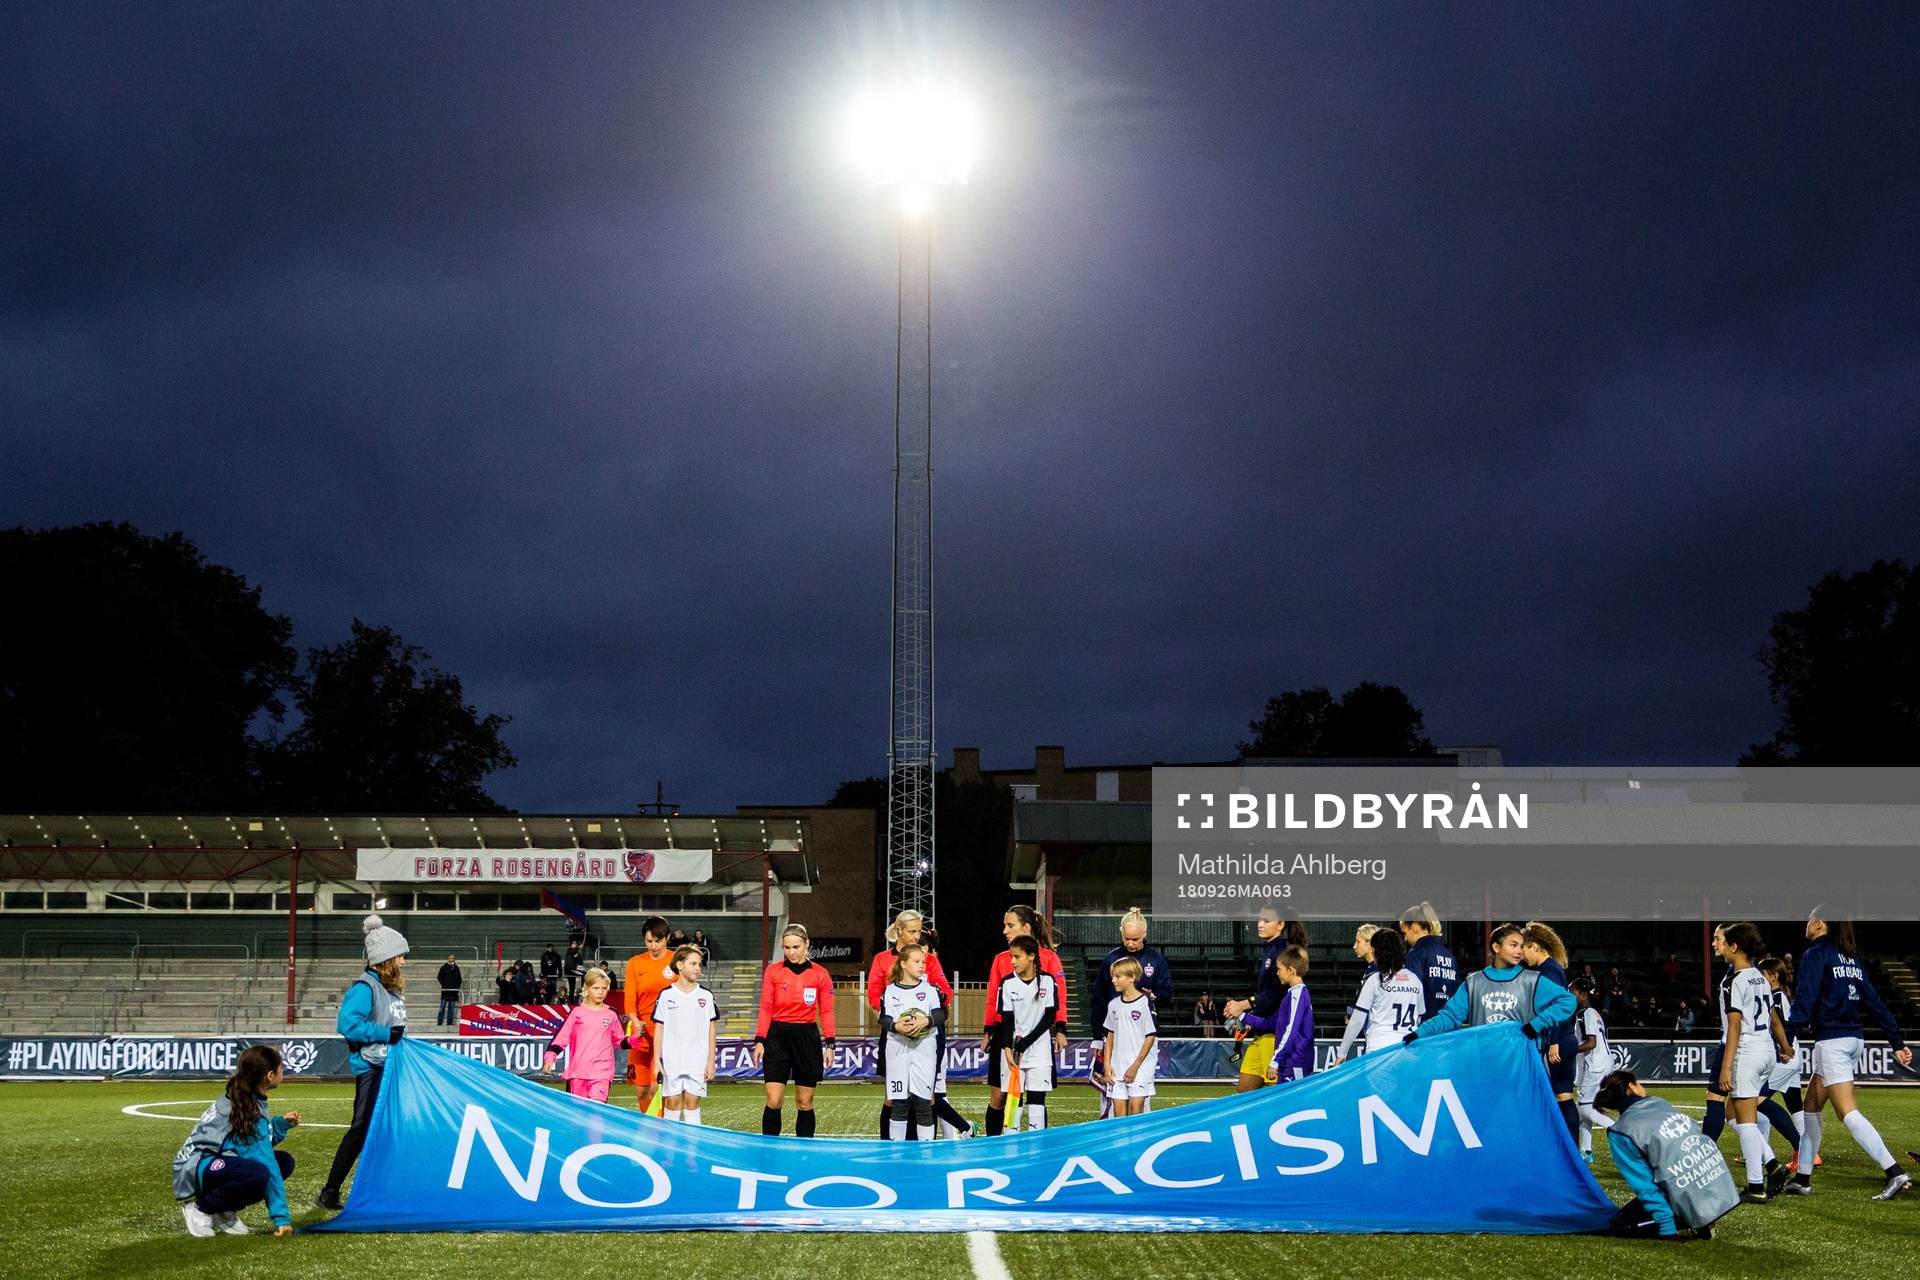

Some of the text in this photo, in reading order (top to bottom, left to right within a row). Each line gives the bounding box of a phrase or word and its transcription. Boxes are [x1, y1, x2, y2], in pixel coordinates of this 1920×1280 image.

[414, 851, 617, 878] FORZA ROSENGÅRD
[1392, 1003, 1416, 1031] 14
[1754, 995, 1770, 1031] 21
[8, 1042, 238, 1070] #PLAYINGFORCHANGE
[502, 1043, 544, 1071] YOU
[890, 1080, 903, 1093] 30
[447, 1079, 1483, 1209] NO TO RACISM
